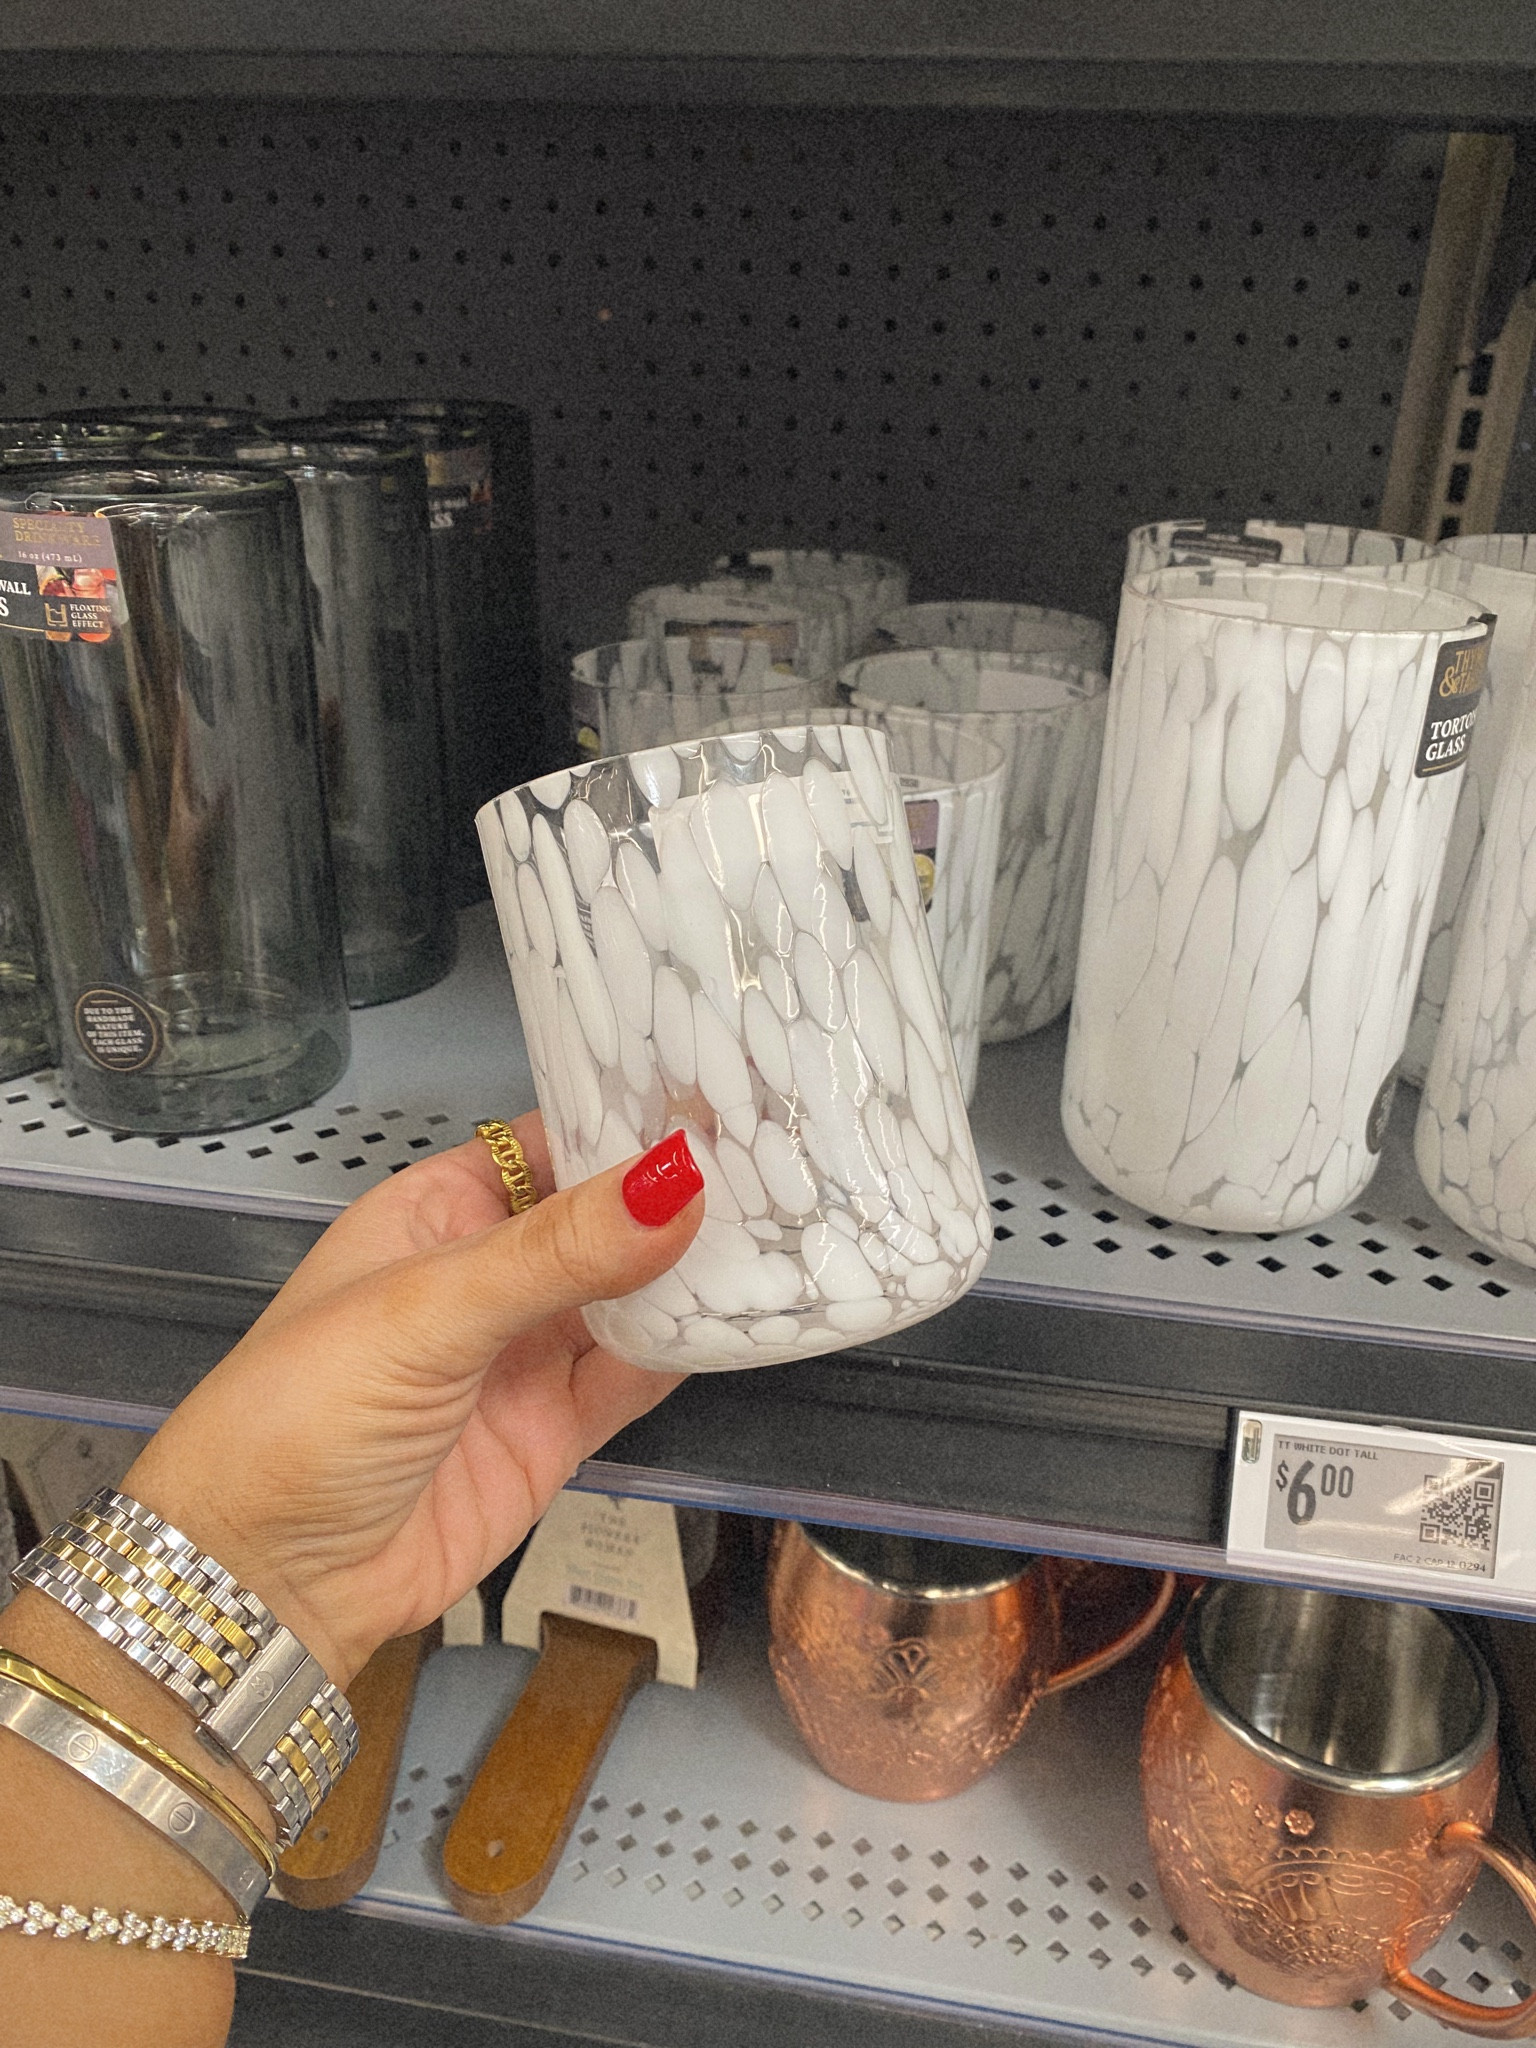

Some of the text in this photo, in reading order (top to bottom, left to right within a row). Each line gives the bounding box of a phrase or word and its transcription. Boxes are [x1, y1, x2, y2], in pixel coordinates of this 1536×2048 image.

[18, 550, 82, 563] 16 oz (473 mL)
[69, 603, 112, 612] FLOATING
[71, 612, 98, 620] GLASS
[72, 620, 104, 628] EFFECT
[1425, 734, 1466, 761] GLASS
[114, 1037, 143, 1045] GLASS
[1294, 1442, 1326, 1454] WHITE
[1329, 1447, 1350, 1456] DOT
[1354, 1449, 1378, 1460] TALL
